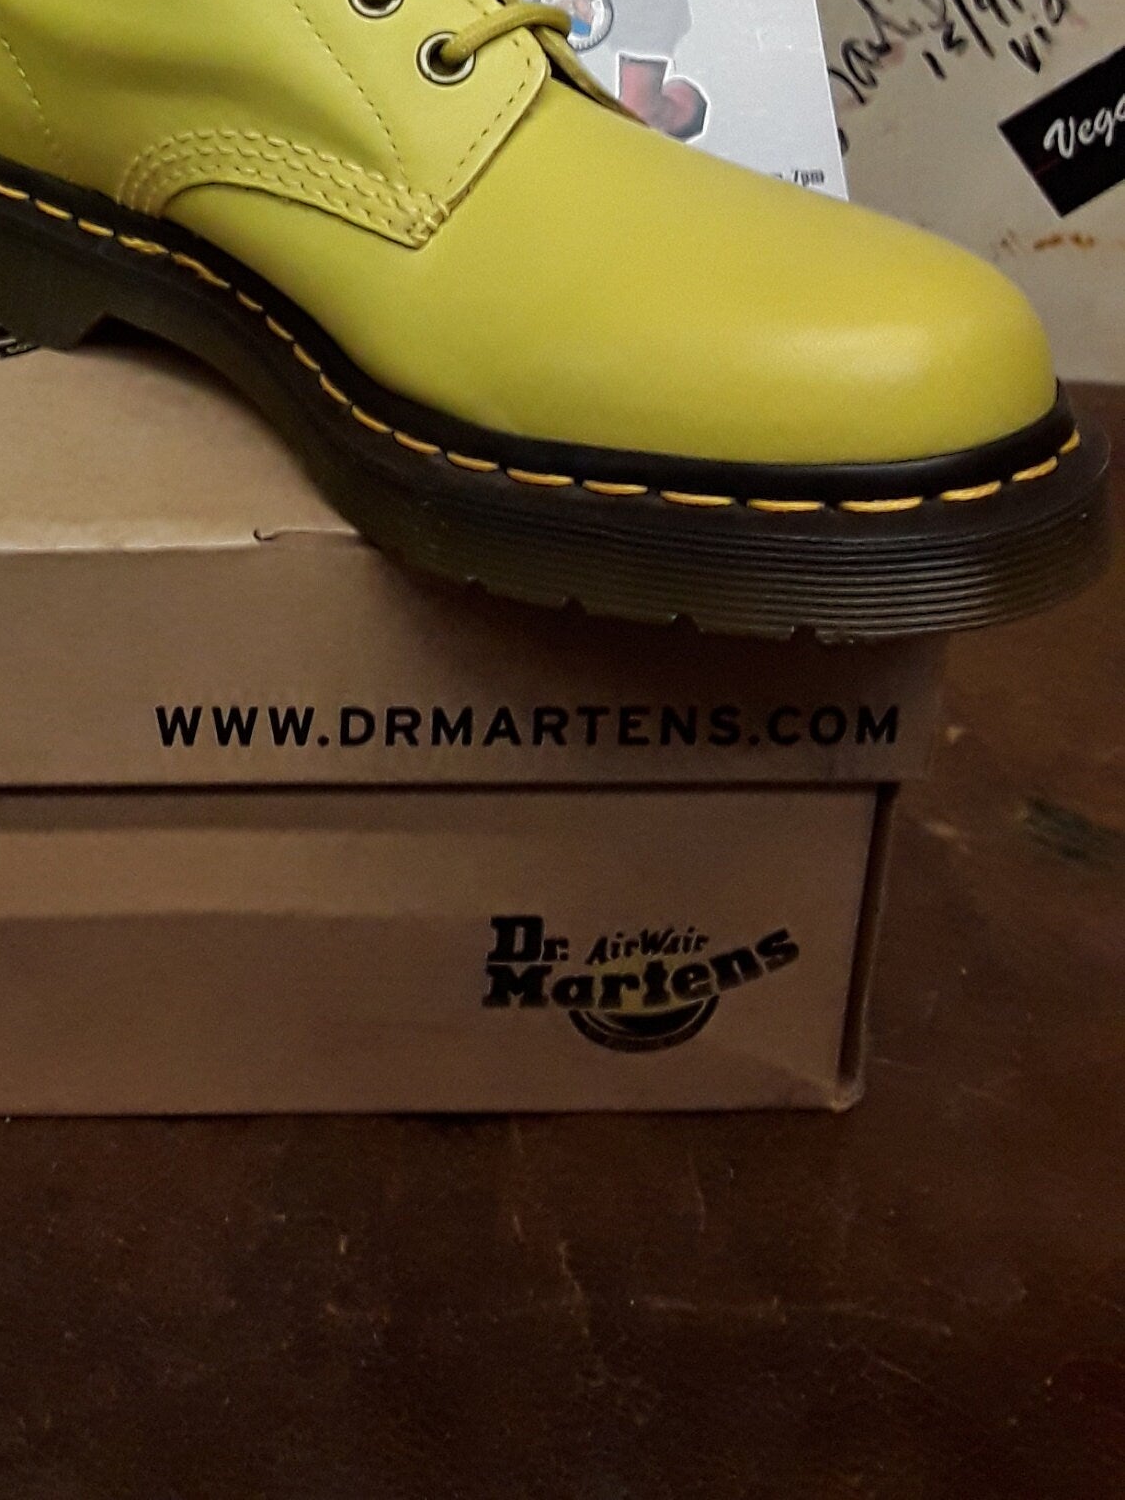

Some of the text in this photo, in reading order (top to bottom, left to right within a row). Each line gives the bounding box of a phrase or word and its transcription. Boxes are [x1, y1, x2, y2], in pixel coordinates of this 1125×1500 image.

[154, 704, 901, 748] WWW.DRMARTENS.COM
[486, 914, 711, 966] Dr. AirWair
[481, 927, 801, 1009] Martens
